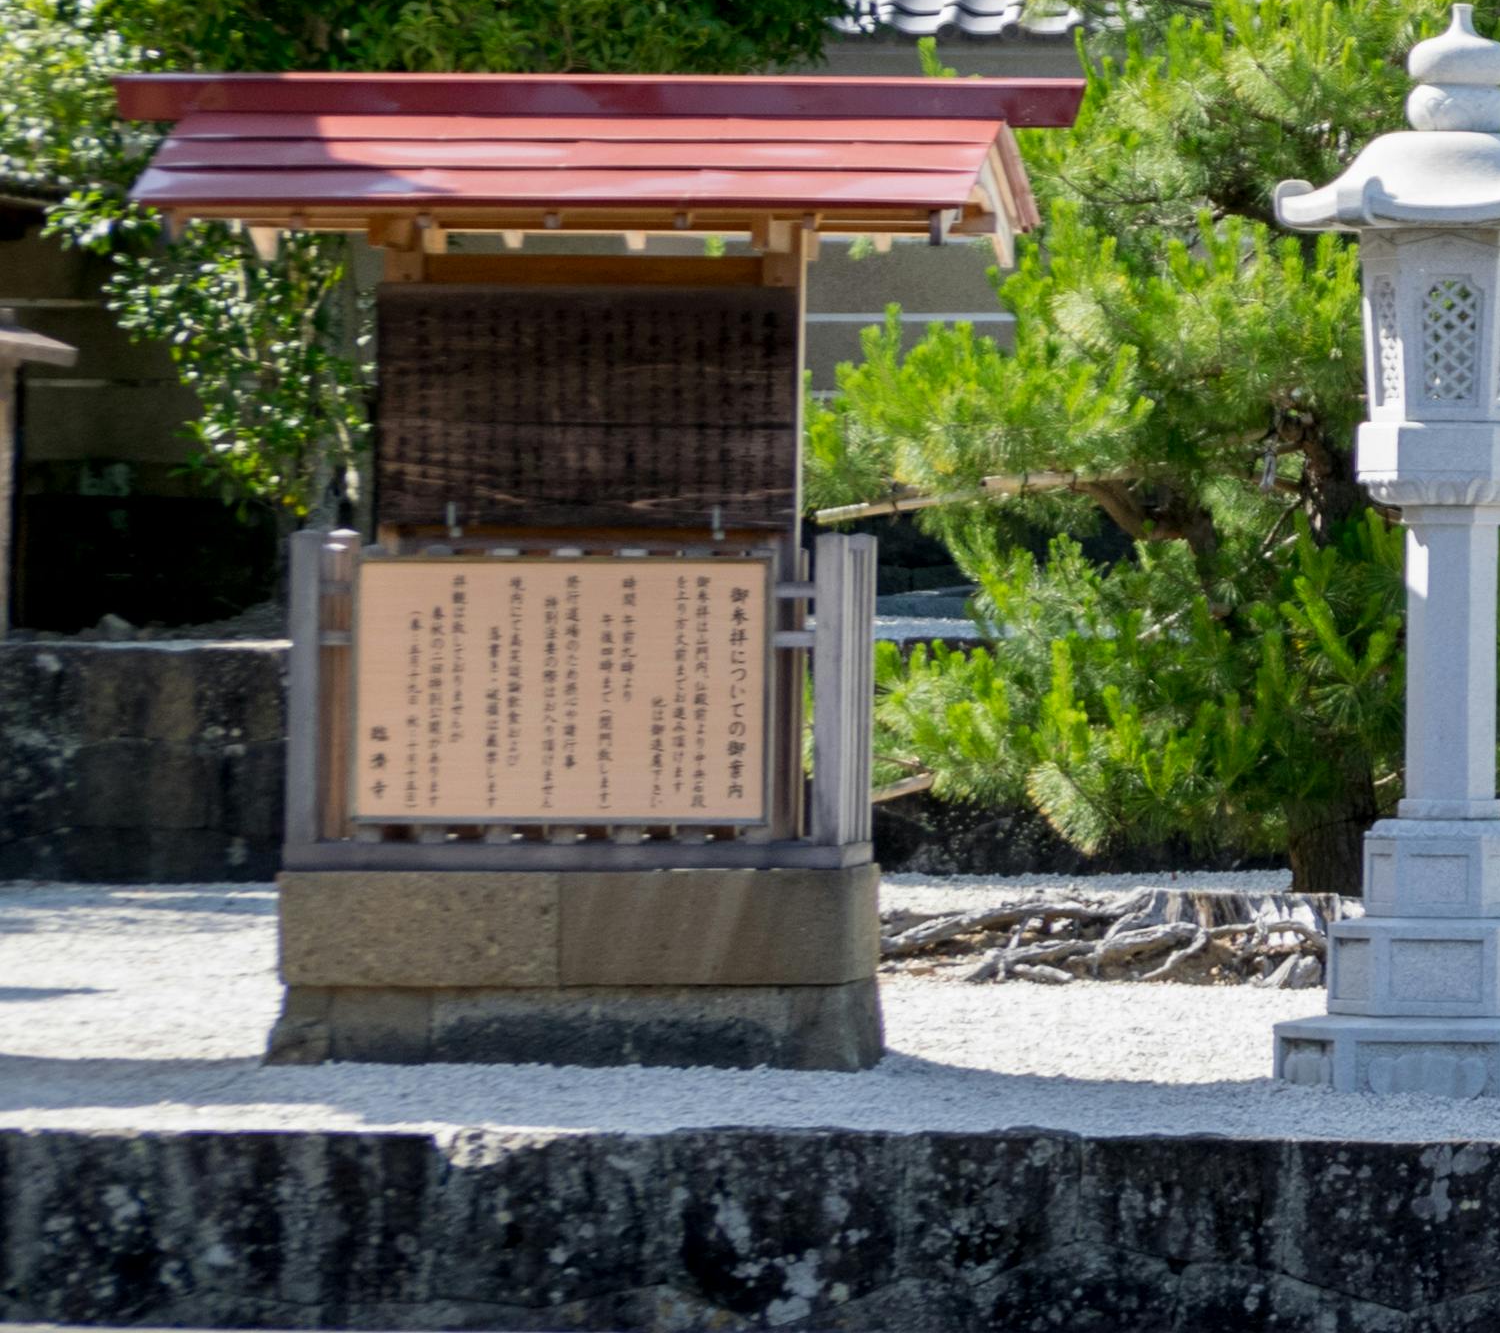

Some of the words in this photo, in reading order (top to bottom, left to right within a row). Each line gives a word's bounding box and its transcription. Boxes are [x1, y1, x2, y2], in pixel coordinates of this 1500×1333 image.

[727, 587, 748, 799] 御参拝についての御案内
